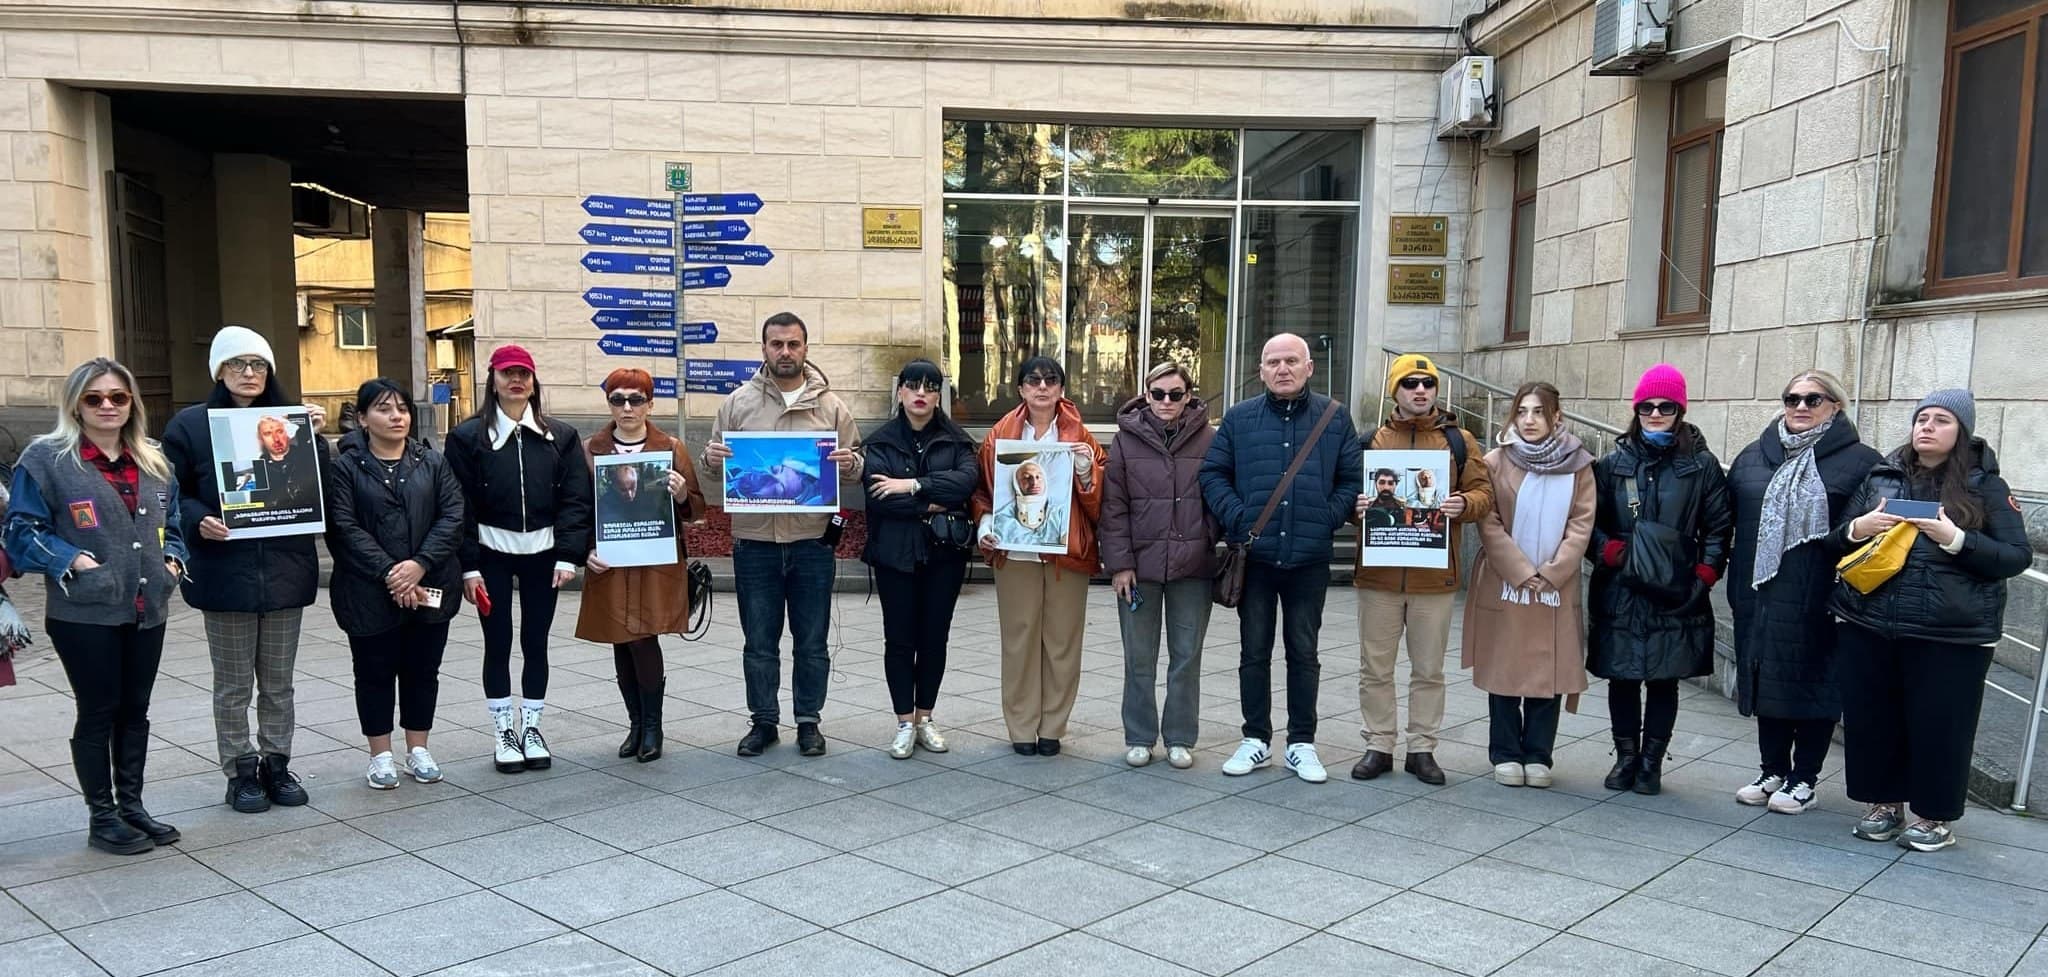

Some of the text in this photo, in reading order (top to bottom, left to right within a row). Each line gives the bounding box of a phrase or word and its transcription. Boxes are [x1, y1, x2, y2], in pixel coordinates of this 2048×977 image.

[650, 210, 671, 218] POLAND
[602, 258, 611, 266] km
[647, 265, 670, 273] UKRAINE
